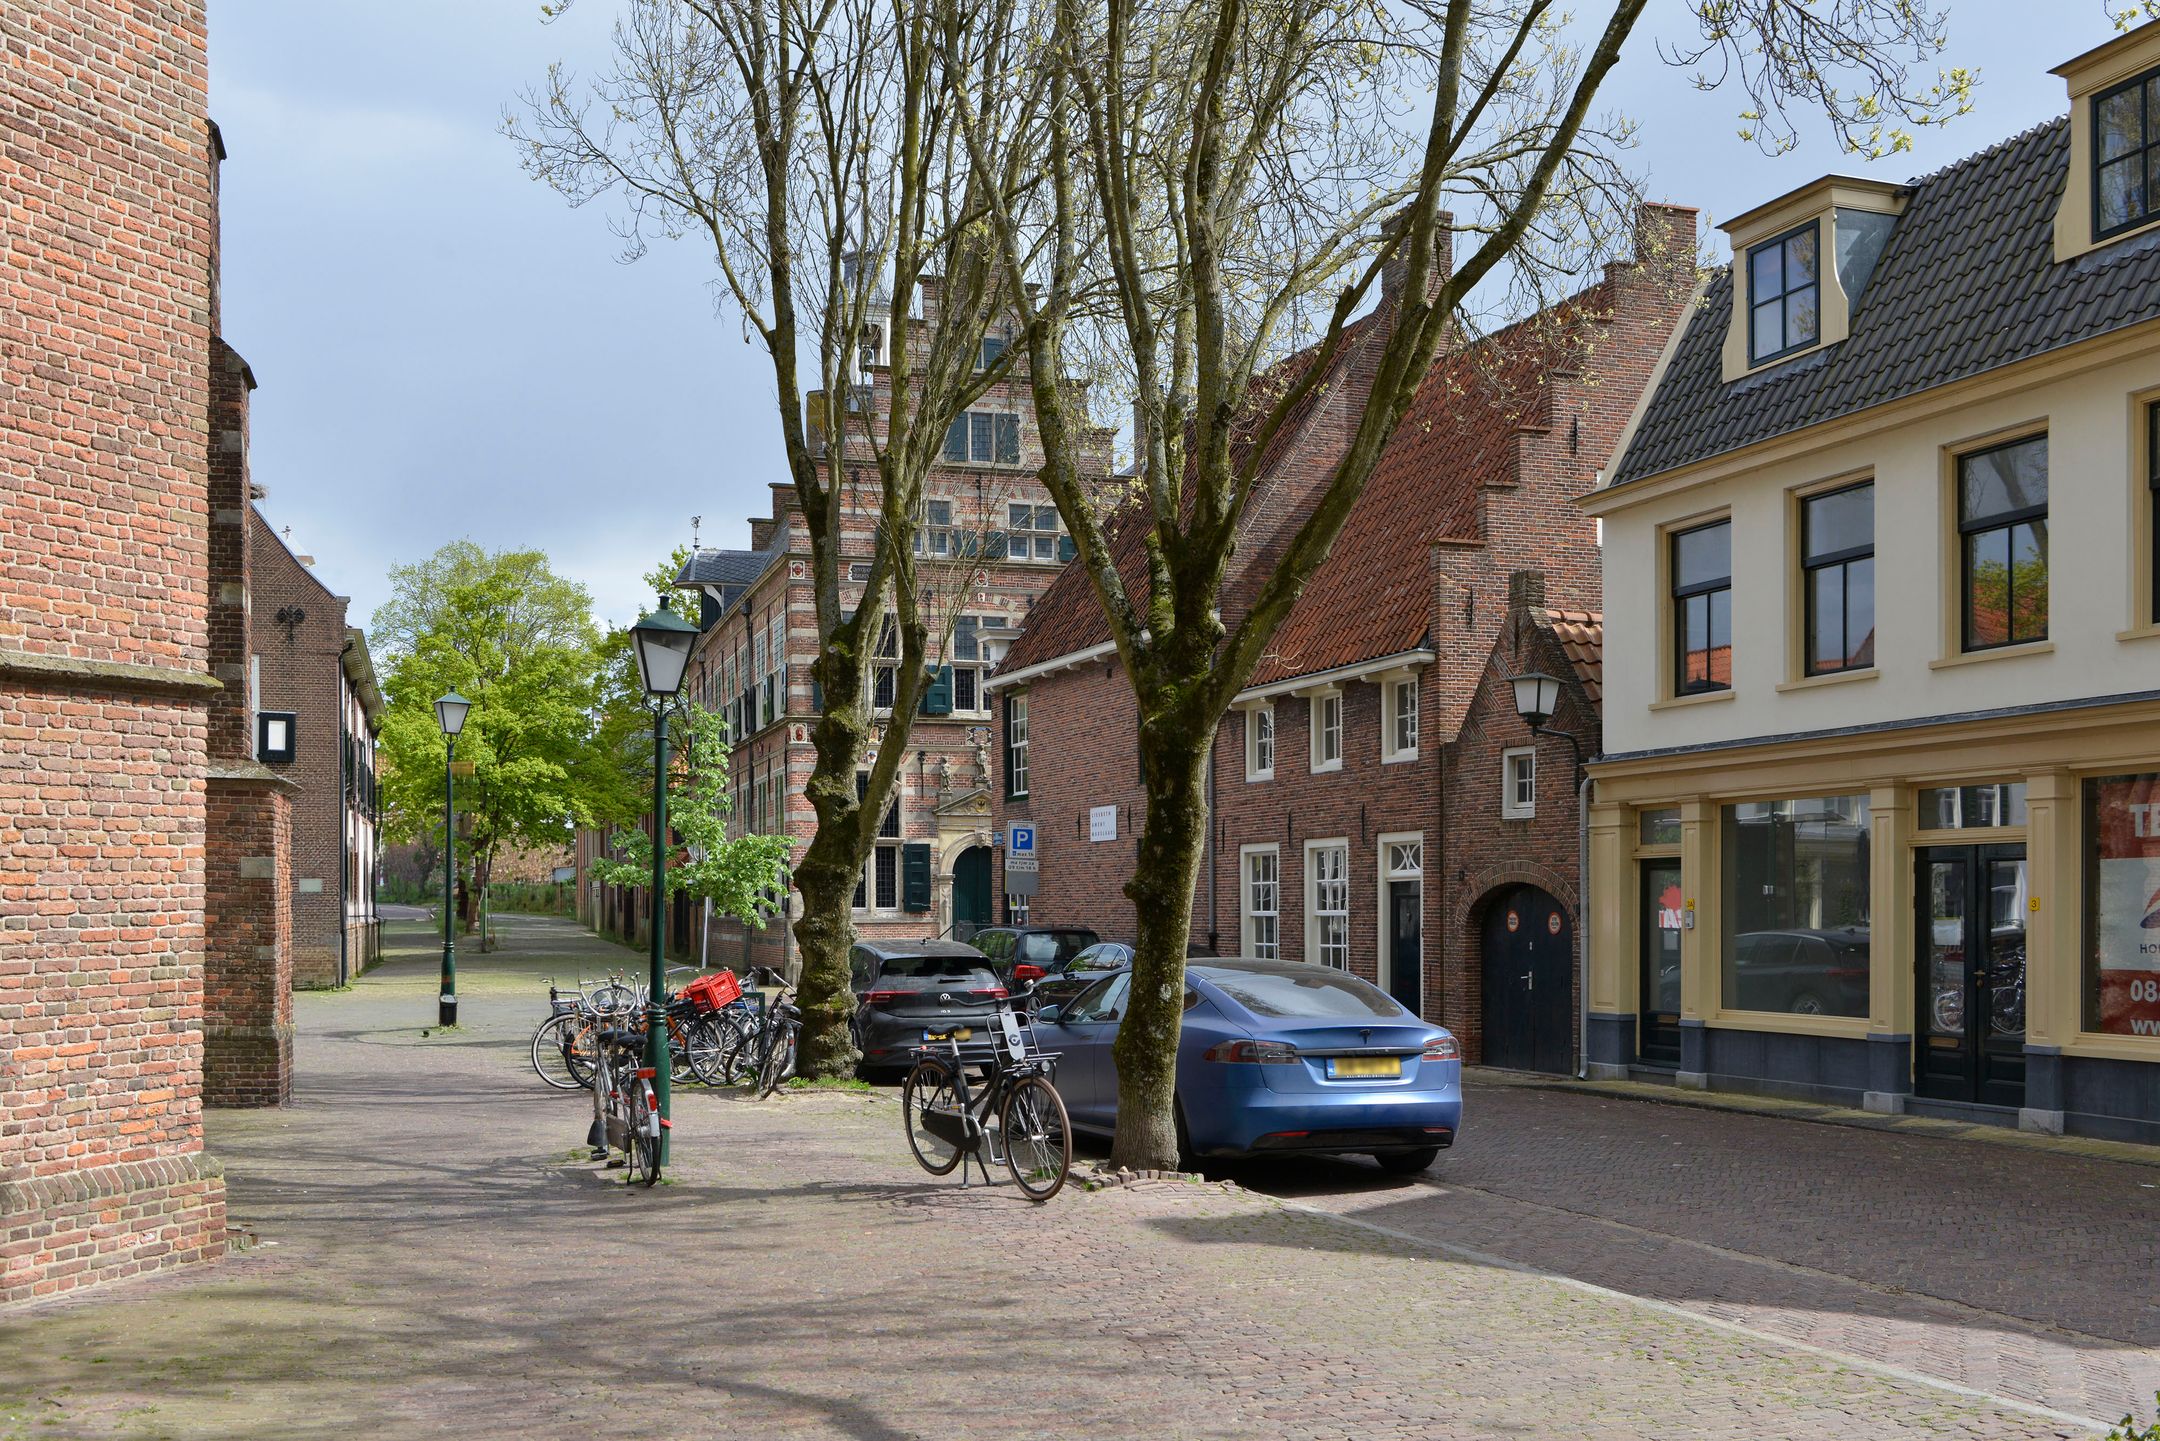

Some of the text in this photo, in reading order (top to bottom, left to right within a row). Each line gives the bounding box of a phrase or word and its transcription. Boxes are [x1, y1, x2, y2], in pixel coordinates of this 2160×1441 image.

[1017, 831, 1028, 847] P
[2031, 900, 2037, 908] 3
[2140, 943, 2160, 954] HO
[2130, 979, 2160, 1002] 08
